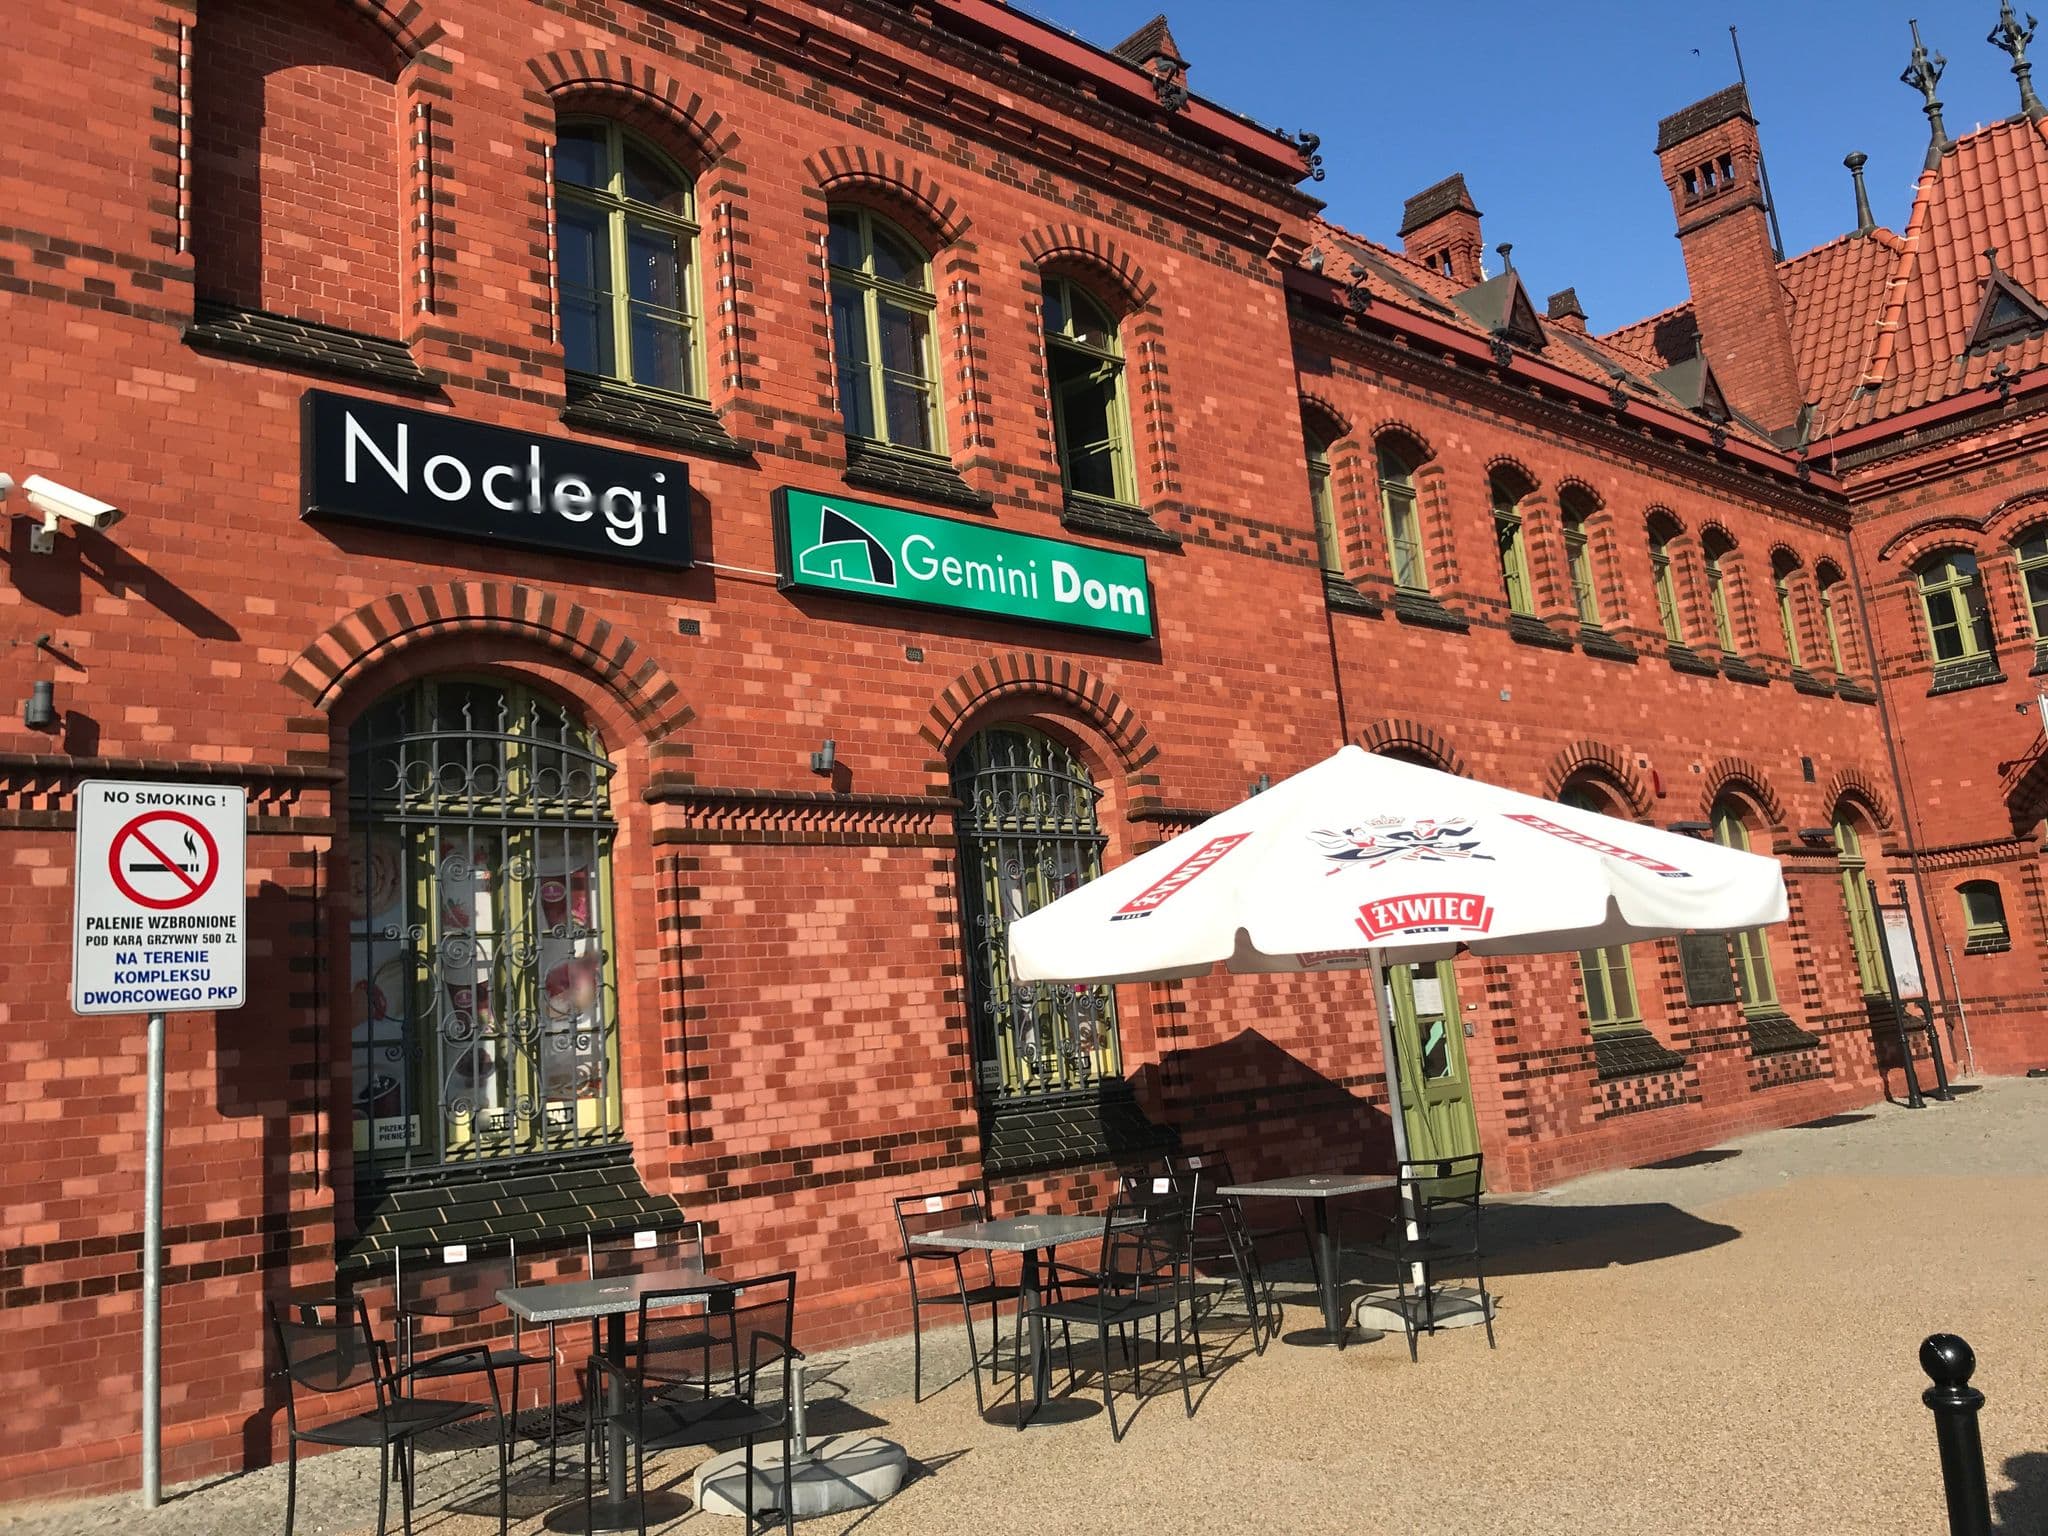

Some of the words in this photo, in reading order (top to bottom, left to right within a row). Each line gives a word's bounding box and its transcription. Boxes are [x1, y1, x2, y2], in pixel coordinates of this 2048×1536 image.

[345, 410, 667, 546] Noclegi
[901, 534, 1039, 599] Gemini
[1051, 560, 1146, 616] Dom
[104, 791, 129, 803] NO
[135, 792, 217, 806] SMOKING
[1371, 897, 1476, 928] ŻYWIEC
[86, 916, 143, 930] PALENIE
[148, 915, 237, 929] WZBRONIONE
[86, 935, 108, 946] POD
[113, 935, 143, 947] KARĄ
[147, 934, 198, 945] GRZYWNY
[202, 933, 221, 944] 500
[225, 933, 237, 943] ZŁ
[116, 952, 138, 965] NA
[144, 951, 209, 964] TERENIE
[114, 969, 210, 984] KOMPLEKSU
[84, 987, 201, 1005] DWORCOWEGO
[207, 986, 238, 999] PKP
